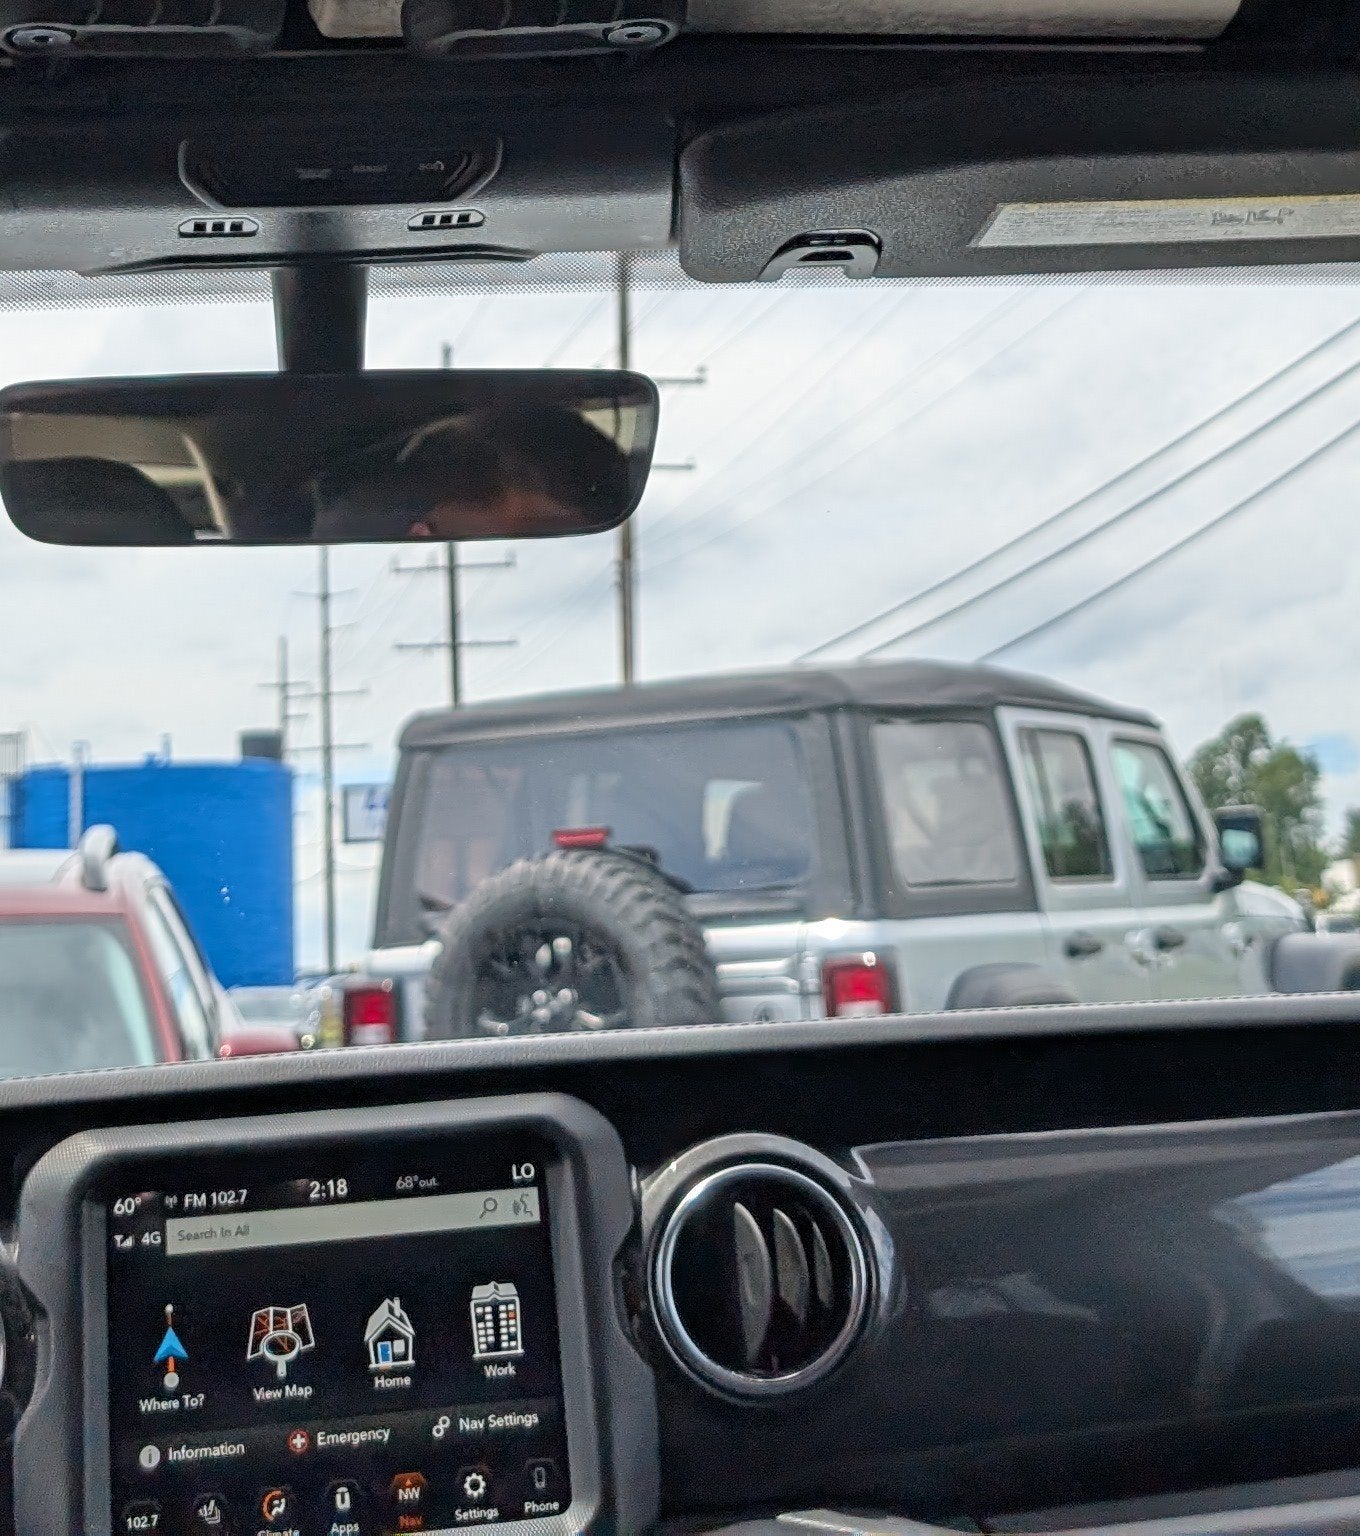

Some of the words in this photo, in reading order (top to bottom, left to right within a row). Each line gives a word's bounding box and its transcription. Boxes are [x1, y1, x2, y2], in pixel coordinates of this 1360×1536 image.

[511, 1163, 535, 1181] LO
[309, 1178, 348, 1199] 2:18
[419, 1176, 437, 1188] out
[183, 1193, 207, 1208] FM
[210, 1189, 247, 1207] 102.7
[141, 1231, 162, 1246] 4G
[178, 1228, 217, 1241] Search
[234, 1224, 250, 1236] All
[484, 1363, 516, 1378] Work
[374, 1375, 411, 1389] Home
[253, 1386, 282, 1400] View
[285, 1384, 313, 1400] Map
[140, 1398, 179, 1412] Where
[182, 1394, 205, 1408] To?
[458, 1418, 485, 1431] Nav
[488, 1413, 539, 1428] Settings
[316, 1428, 391, 1448] Emergency
[168, 1442, 245, 1461] Information
[398, 1486, 421, 1500] NW
[455, 1508, 499, 1522] Settings
[524, 1501, 560, 1514] Phone
[126, 1515, 159, 1530] 102.7
[331, 1523, 360, 1536] Apps
